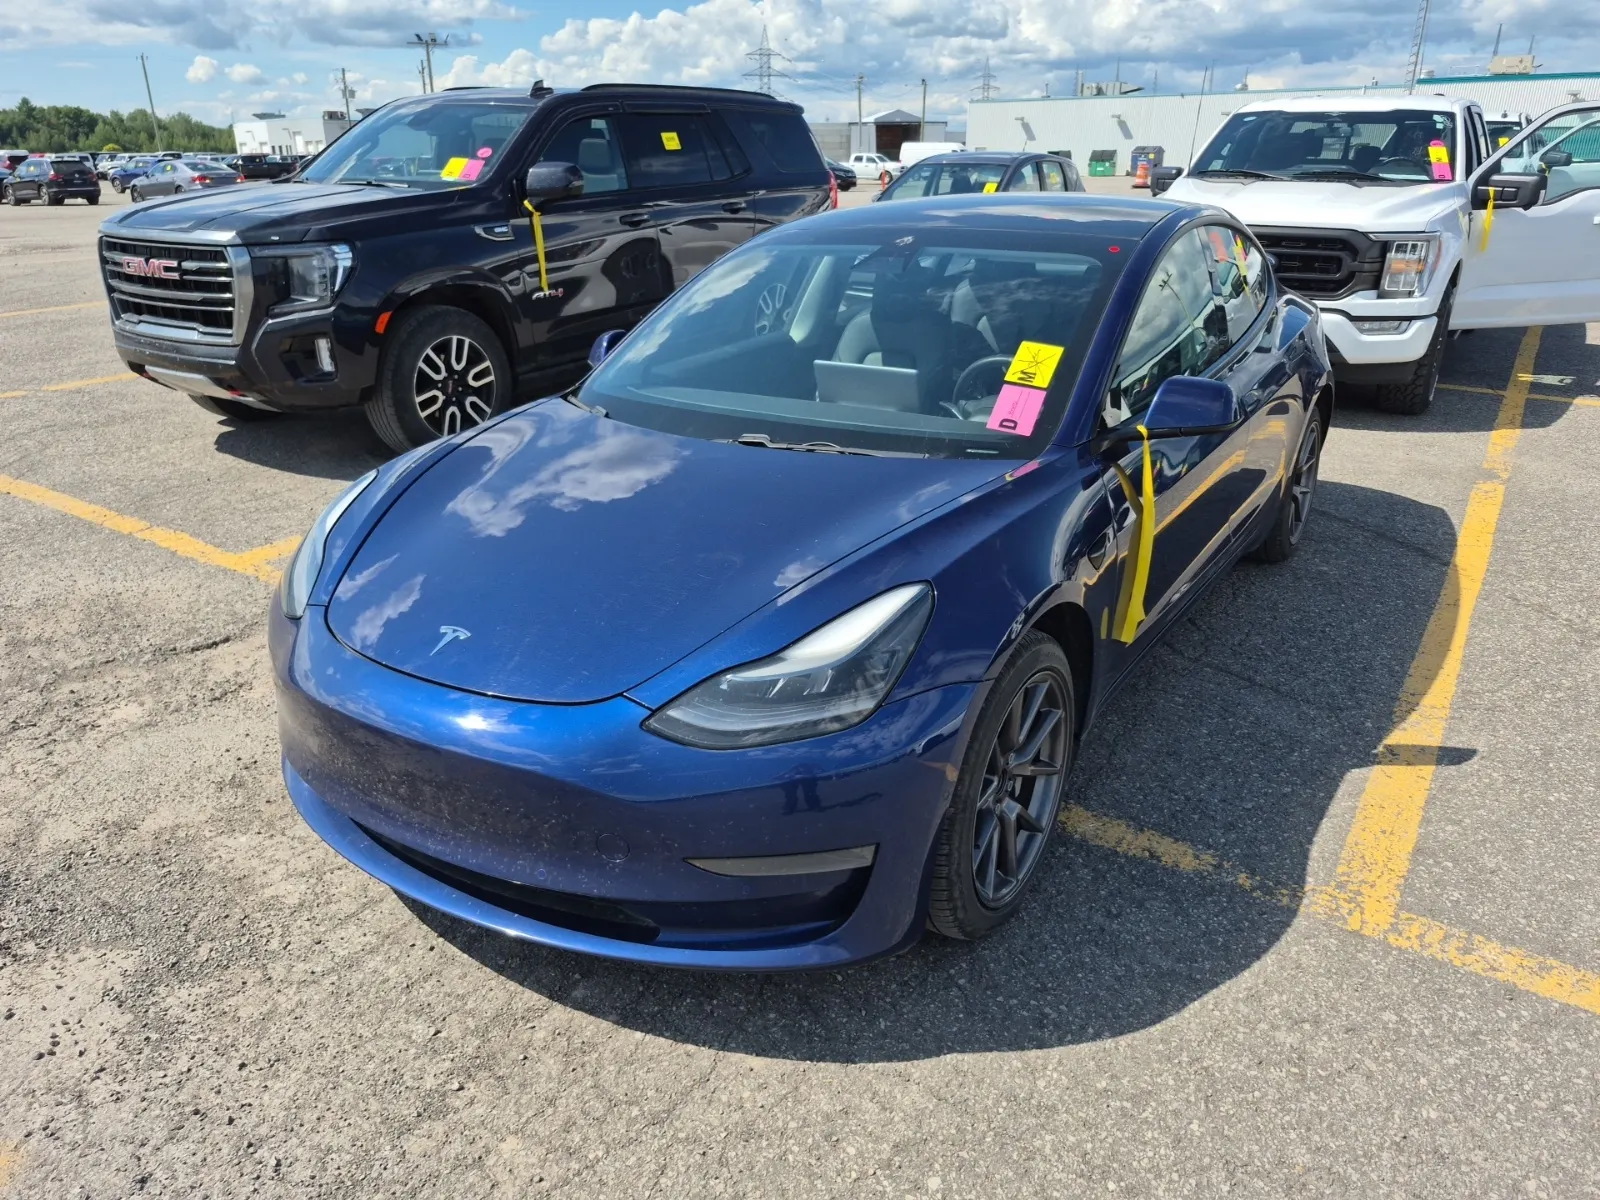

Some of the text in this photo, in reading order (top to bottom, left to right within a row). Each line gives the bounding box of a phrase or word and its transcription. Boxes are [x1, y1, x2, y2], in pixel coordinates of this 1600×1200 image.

[122, 256, 180, 280] GMC
[1016, 369, 1037, 383] M
[998, 418, 1018, 431] D
